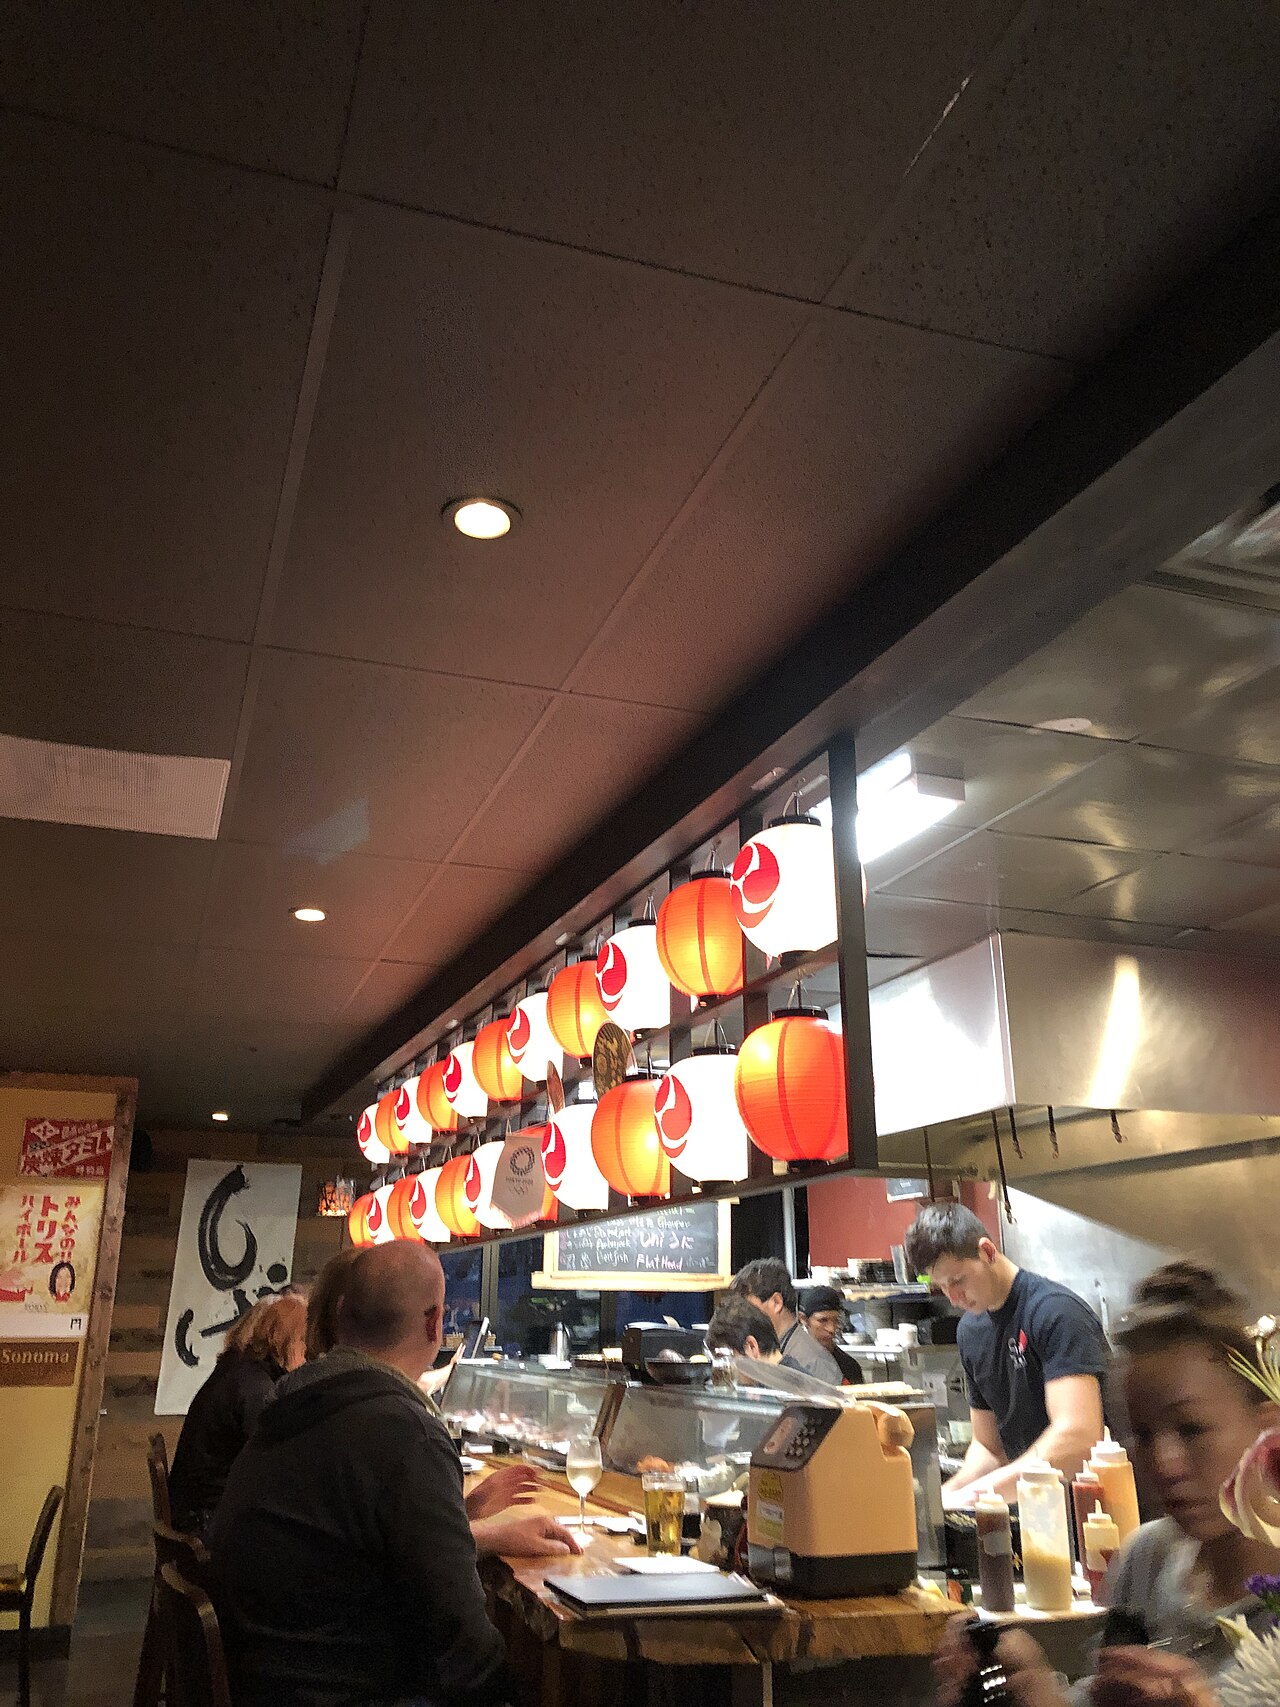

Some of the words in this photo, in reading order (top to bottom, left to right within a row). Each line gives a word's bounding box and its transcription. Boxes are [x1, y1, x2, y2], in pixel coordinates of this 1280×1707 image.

[32, 1195, 59, 1264] トリス
[639, 1229, 664, 1248] Uni
[1, 1348, 69, 1364] Sonoma
